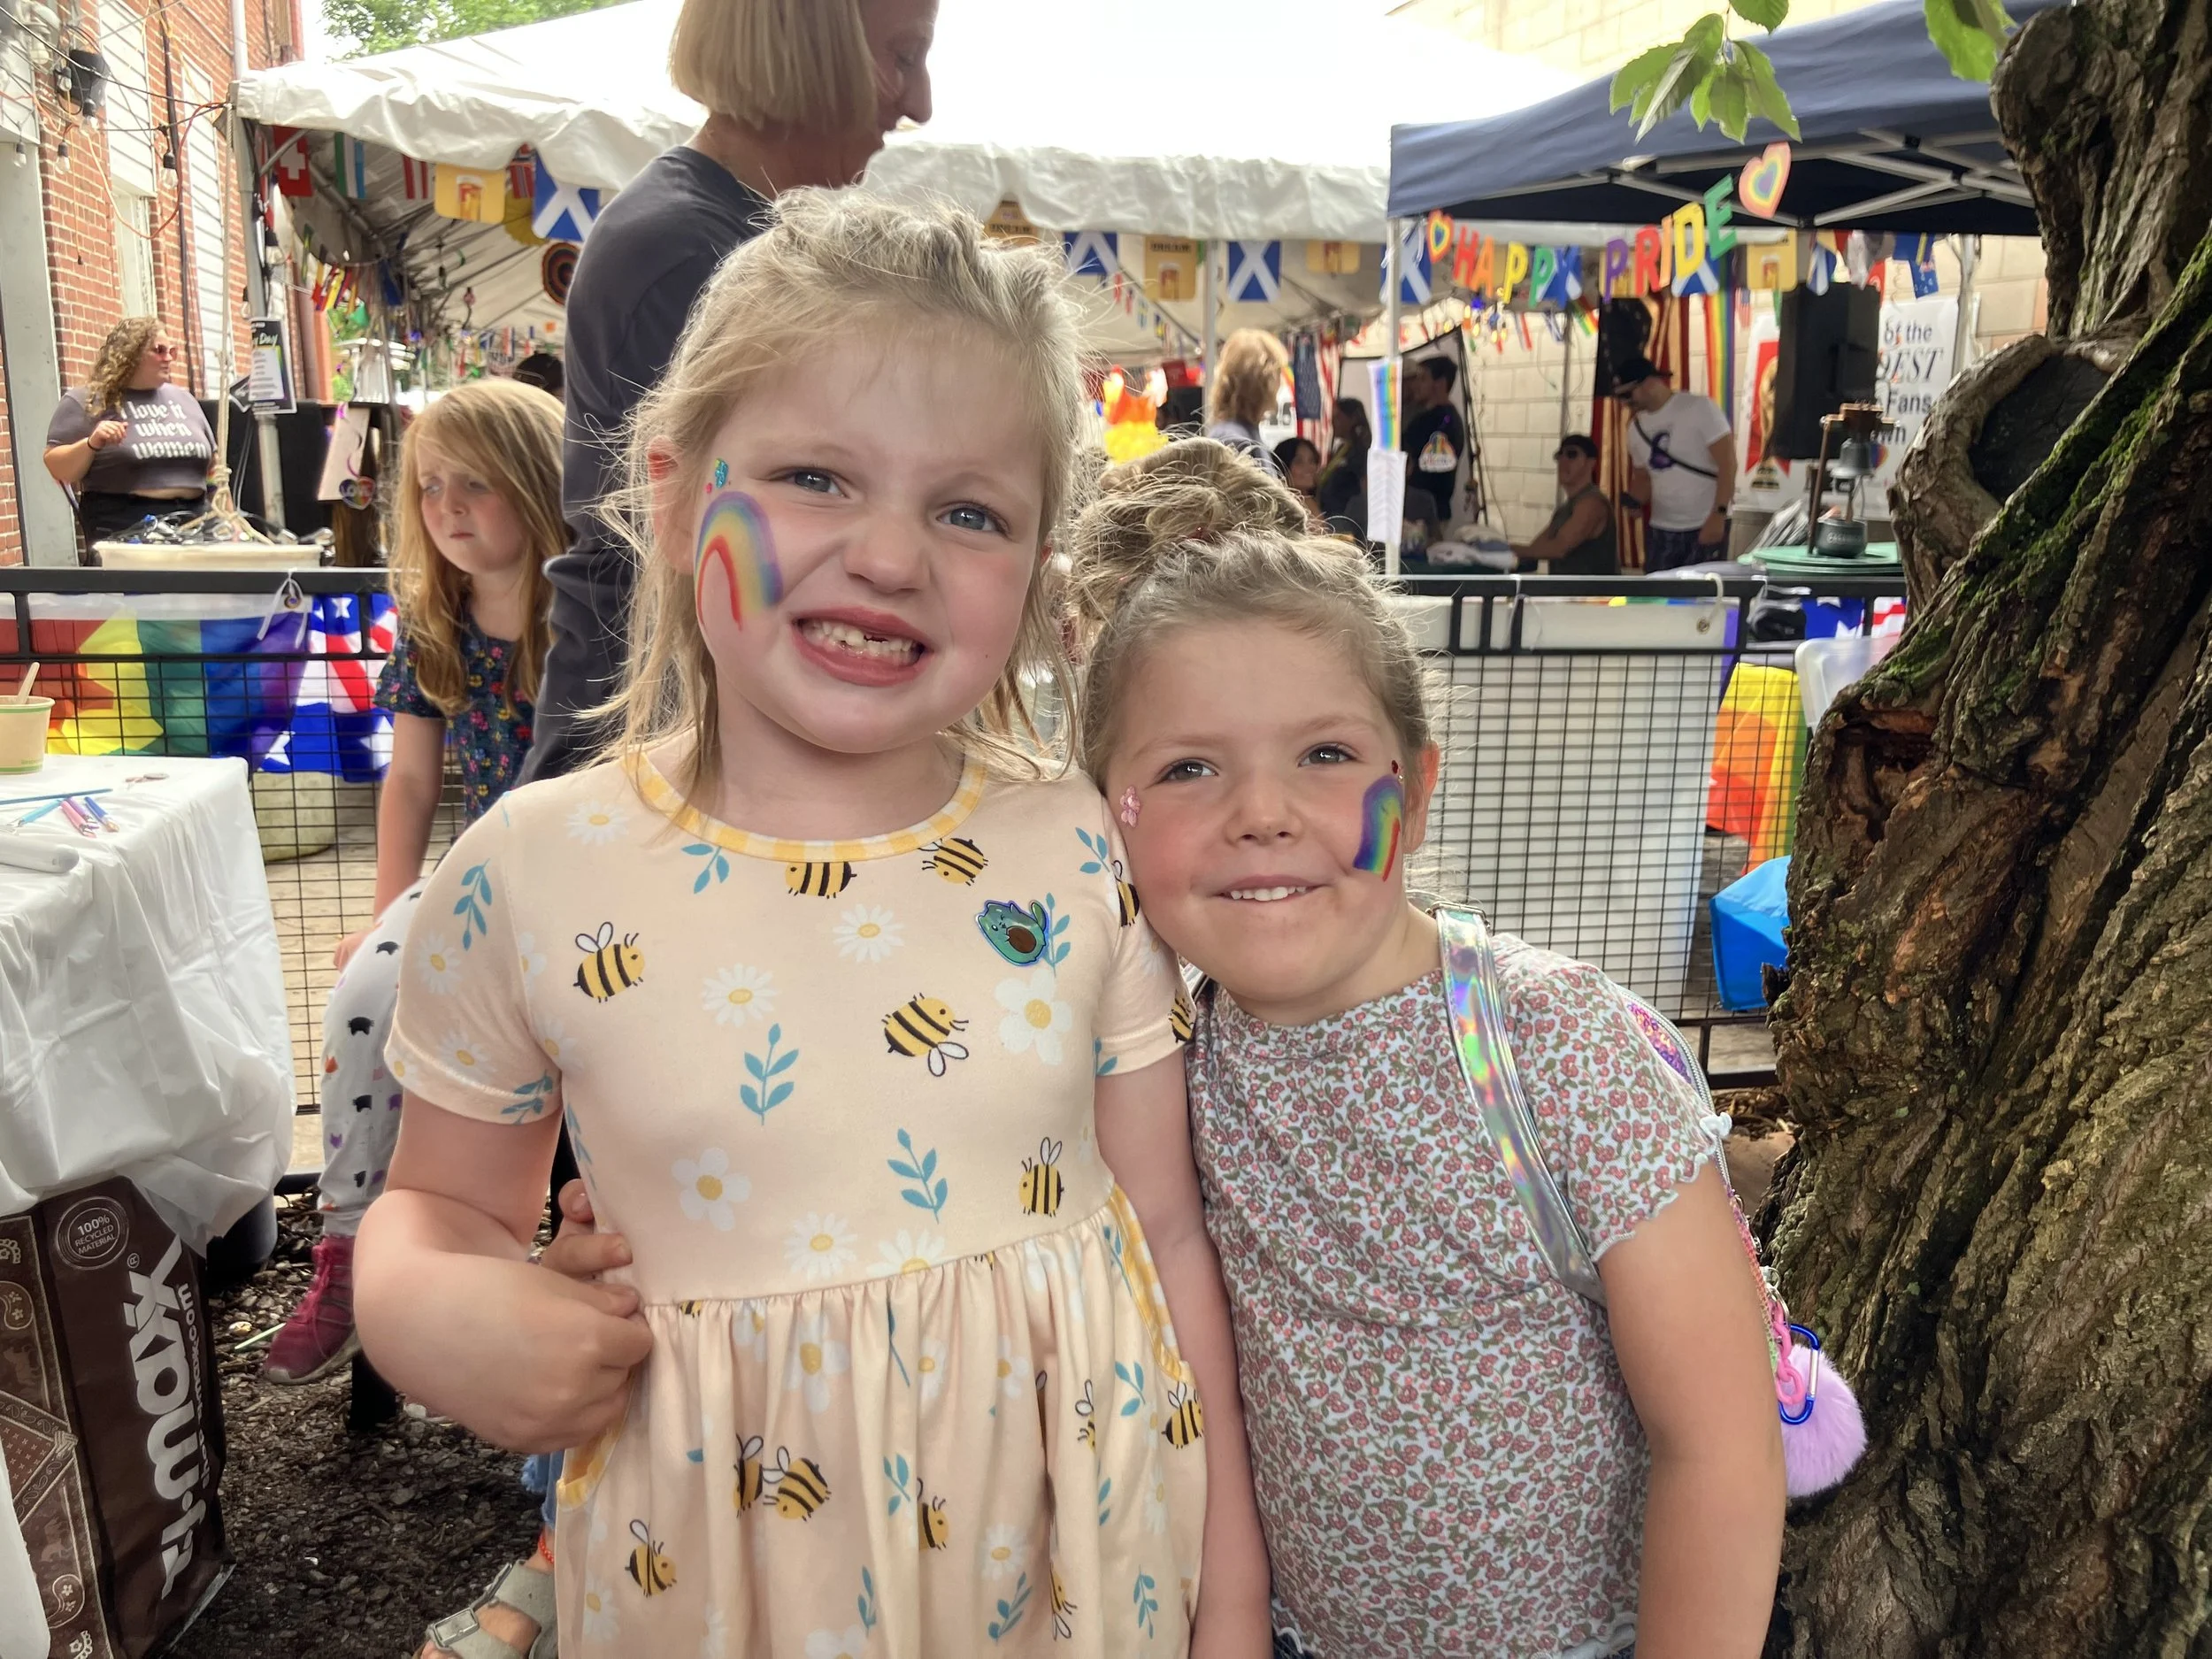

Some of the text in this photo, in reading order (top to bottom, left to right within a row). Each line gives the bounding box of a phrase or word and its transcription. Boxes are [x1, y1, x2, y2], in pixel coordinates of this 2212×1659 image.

[1453, 173, 1737, 309] HAPPY PRIDE
[1907, 321, 1932, 343] the
[127, 401, 168, 419] love
[168, 400, 187, 419] it
[1886, 390, 1931, 416] Fans
[134, 419, 192, 437] when
[132, 442, 207, 459] women
[78, 1214, 110, 1235] 100%
[74, 1225, 113, 1247] RECYCLED
[78, 1233, 115, 1254] MATERIAL
